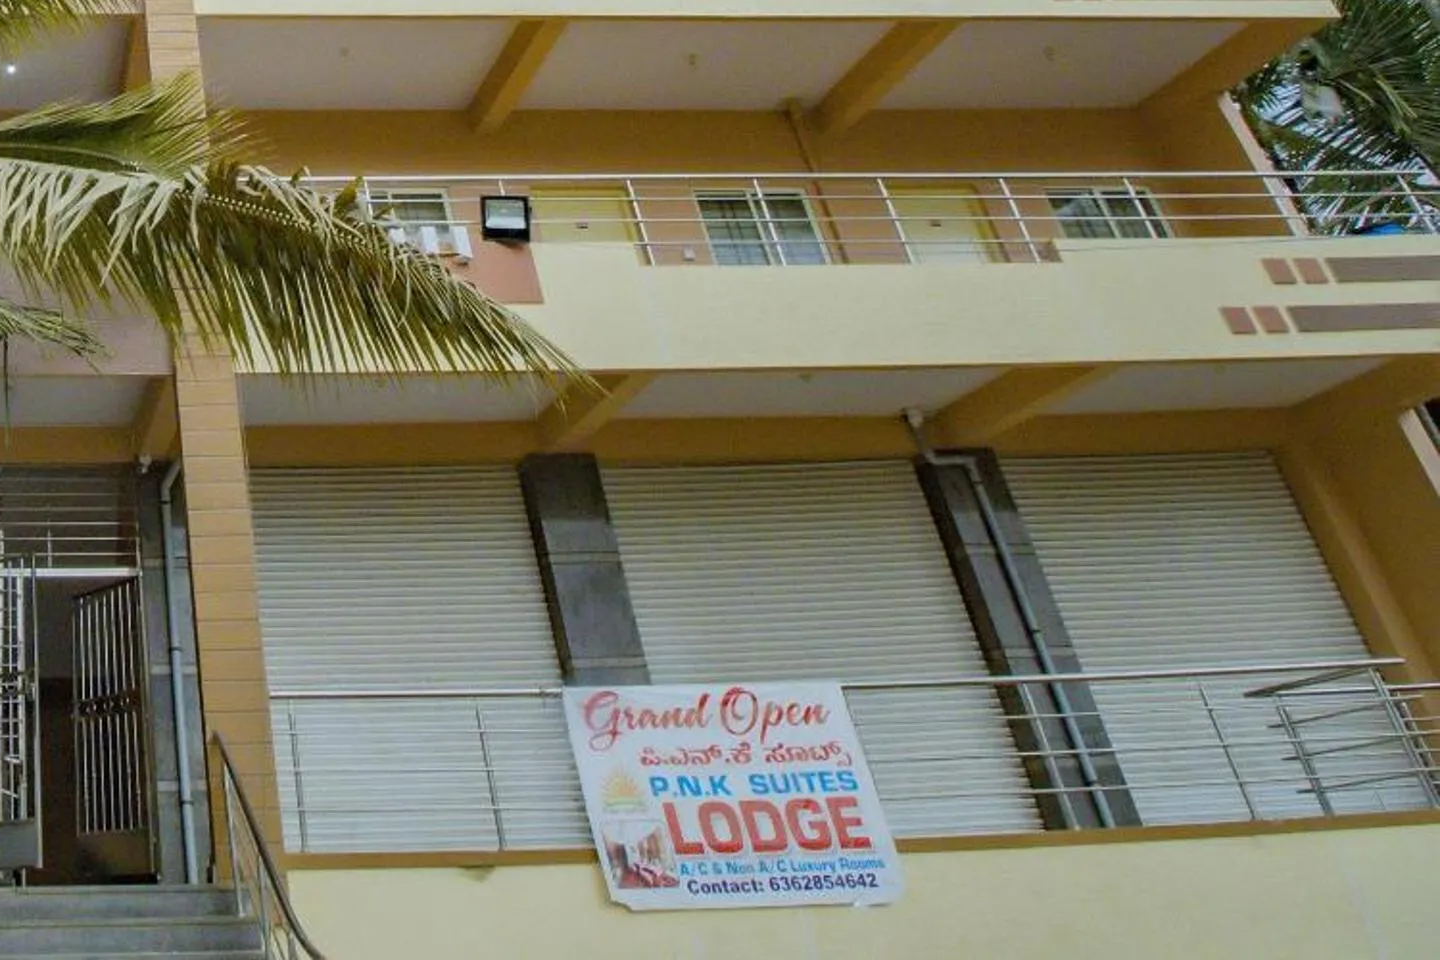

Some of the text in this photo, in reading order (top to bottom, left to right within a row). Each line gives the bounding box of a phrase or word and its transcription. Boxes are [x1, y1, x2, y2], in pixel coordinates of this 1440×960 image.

[583, 686, 832, 751] Grand Open
[649, 770, 859, 797] P.N.K SUITES
[663, 796, 872, 855] LODGE
[726, 861, 755, 874] Non
[759, 859, 787, 873] A/C
[791, 858, 836, 874] Luxury
[839, 857, 886, 870] Rooms
[687, 873, 879, 895] Contact: 6362854642
